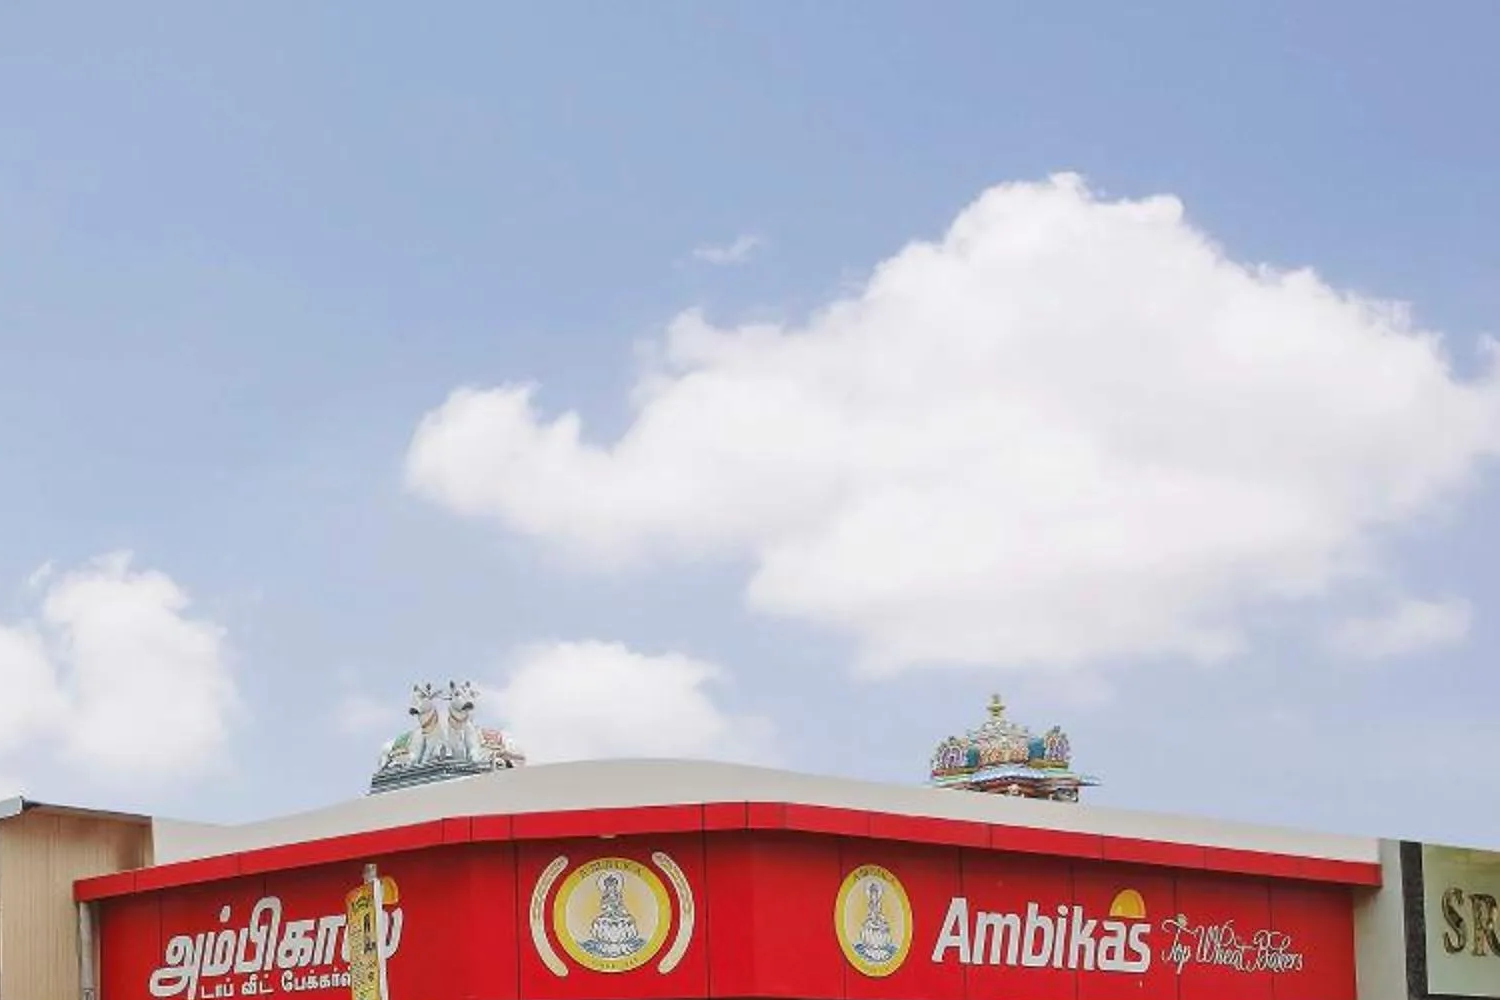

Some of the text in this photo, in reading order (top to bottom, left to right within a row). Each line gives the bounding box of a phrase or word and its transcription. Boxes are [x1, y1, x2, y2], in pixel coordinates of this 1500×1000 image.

[932, 897, 1151, 973] Ambikas
[1162, 914, 1198, 974] Top
[1194, 920, 1257, 971] Wheat
